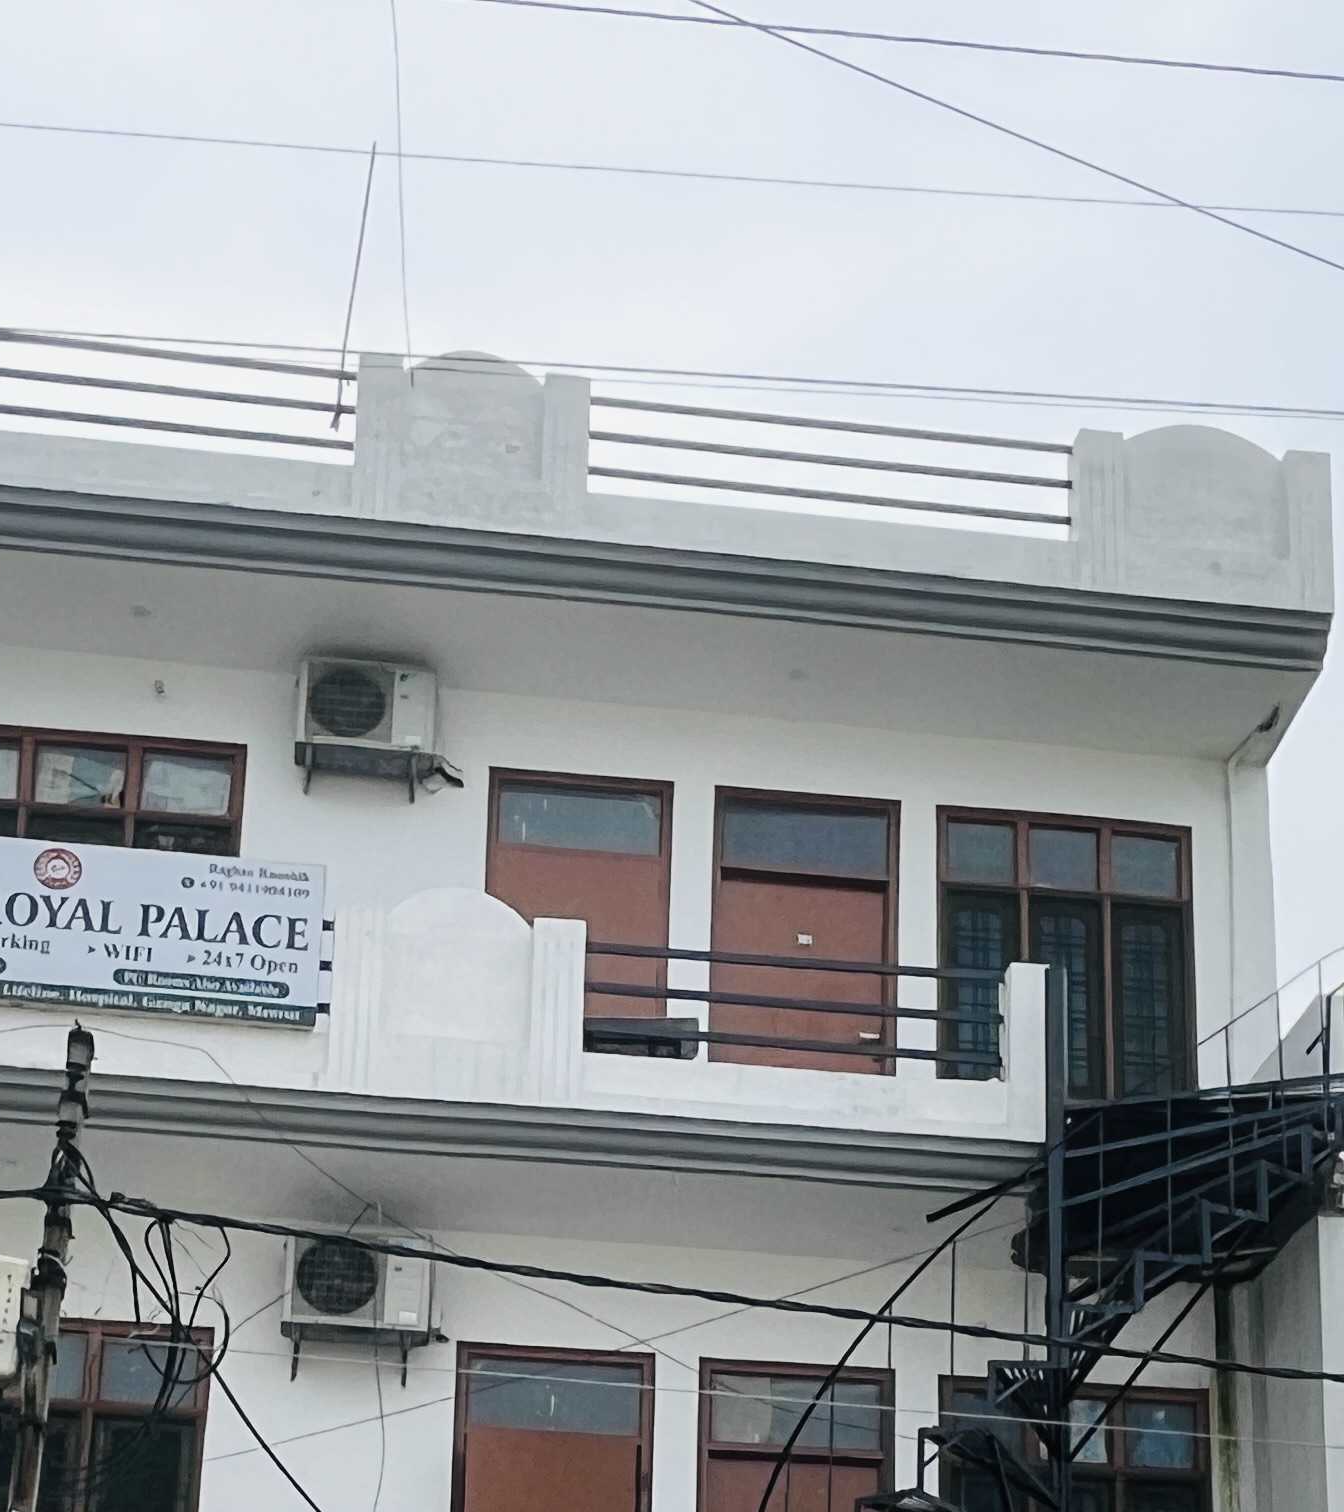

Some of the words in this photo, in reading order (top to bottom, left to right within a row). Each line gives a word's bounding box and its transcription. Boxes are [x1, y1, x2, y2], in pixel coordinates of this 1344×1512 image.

[137, 903, 309, 951] PALACE
[103, 943, 153, 963] WIFI
[201, 949, 245, 968] 24x7
[250, 953, 299, 976] Open
